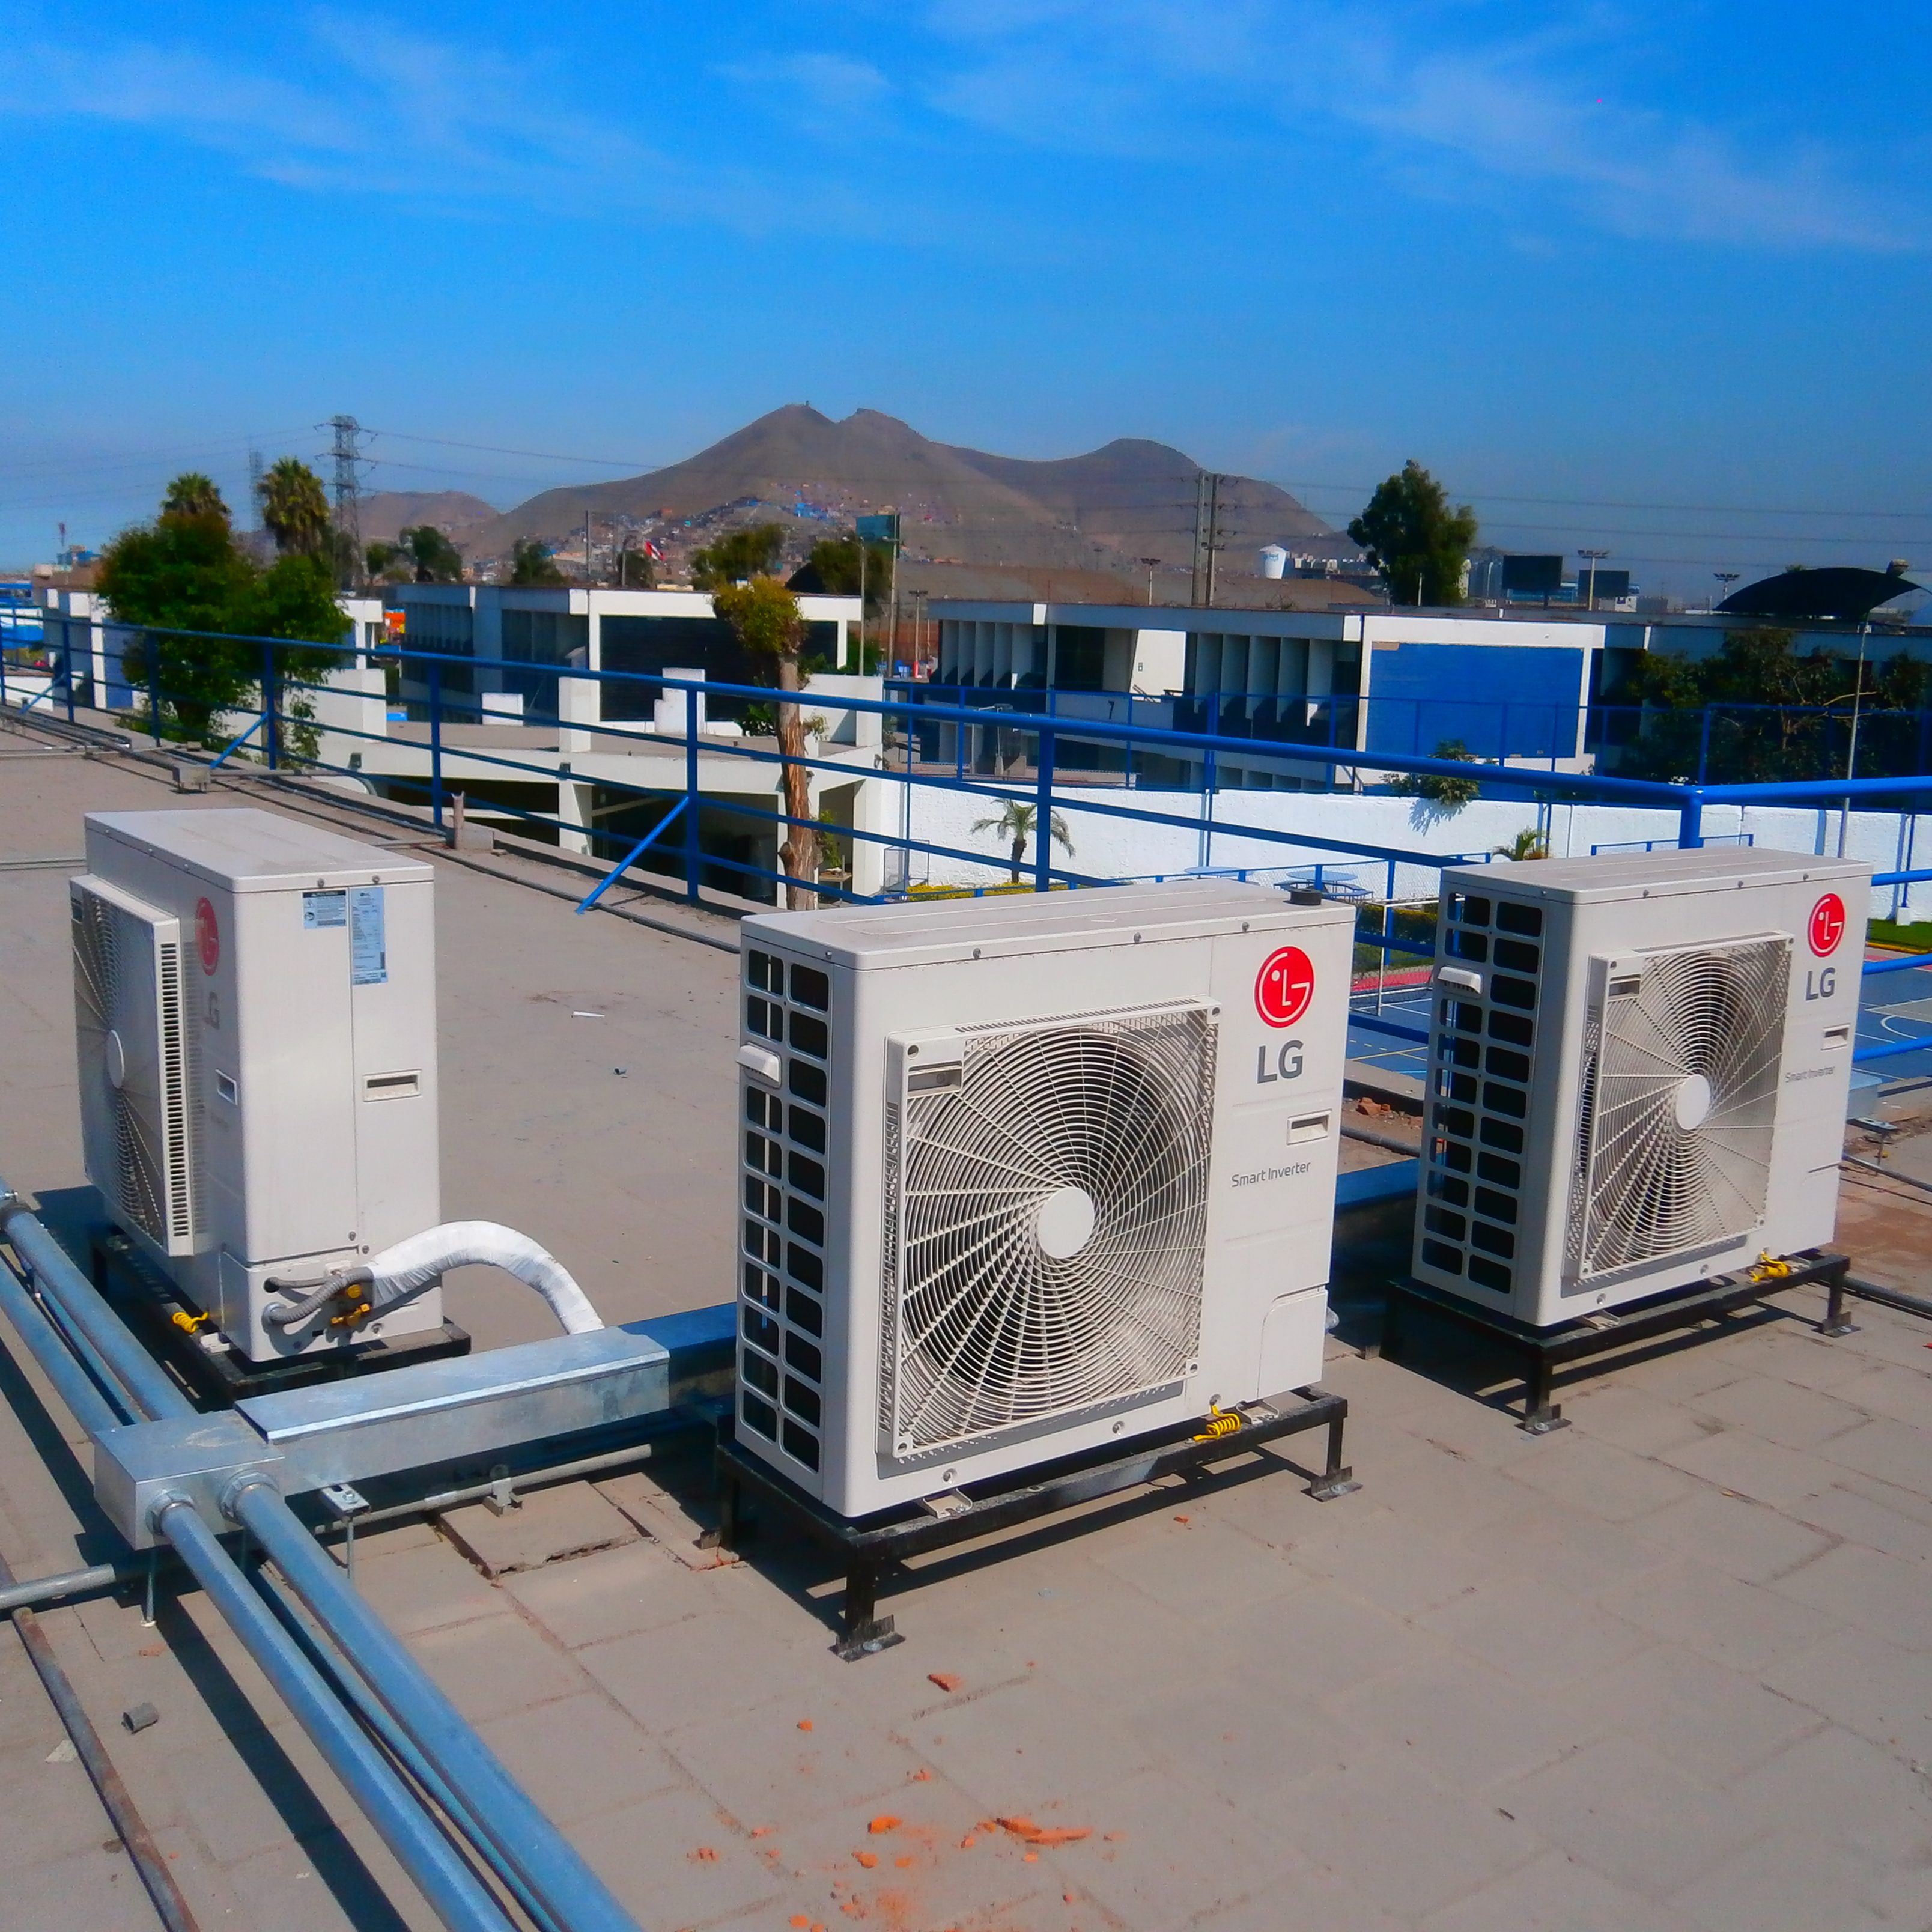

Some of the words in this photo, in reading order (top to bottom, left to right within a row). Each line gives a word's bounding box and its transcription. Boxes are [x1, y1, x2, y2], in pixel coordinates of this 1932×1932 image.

[1805, 967, 1836, 1001] LG
[1257, 1040, 1304, 1084] LG
[1231, 1170, 1266, 1188] Smart
[1268, 1162, 1311, 1180] Inverter
